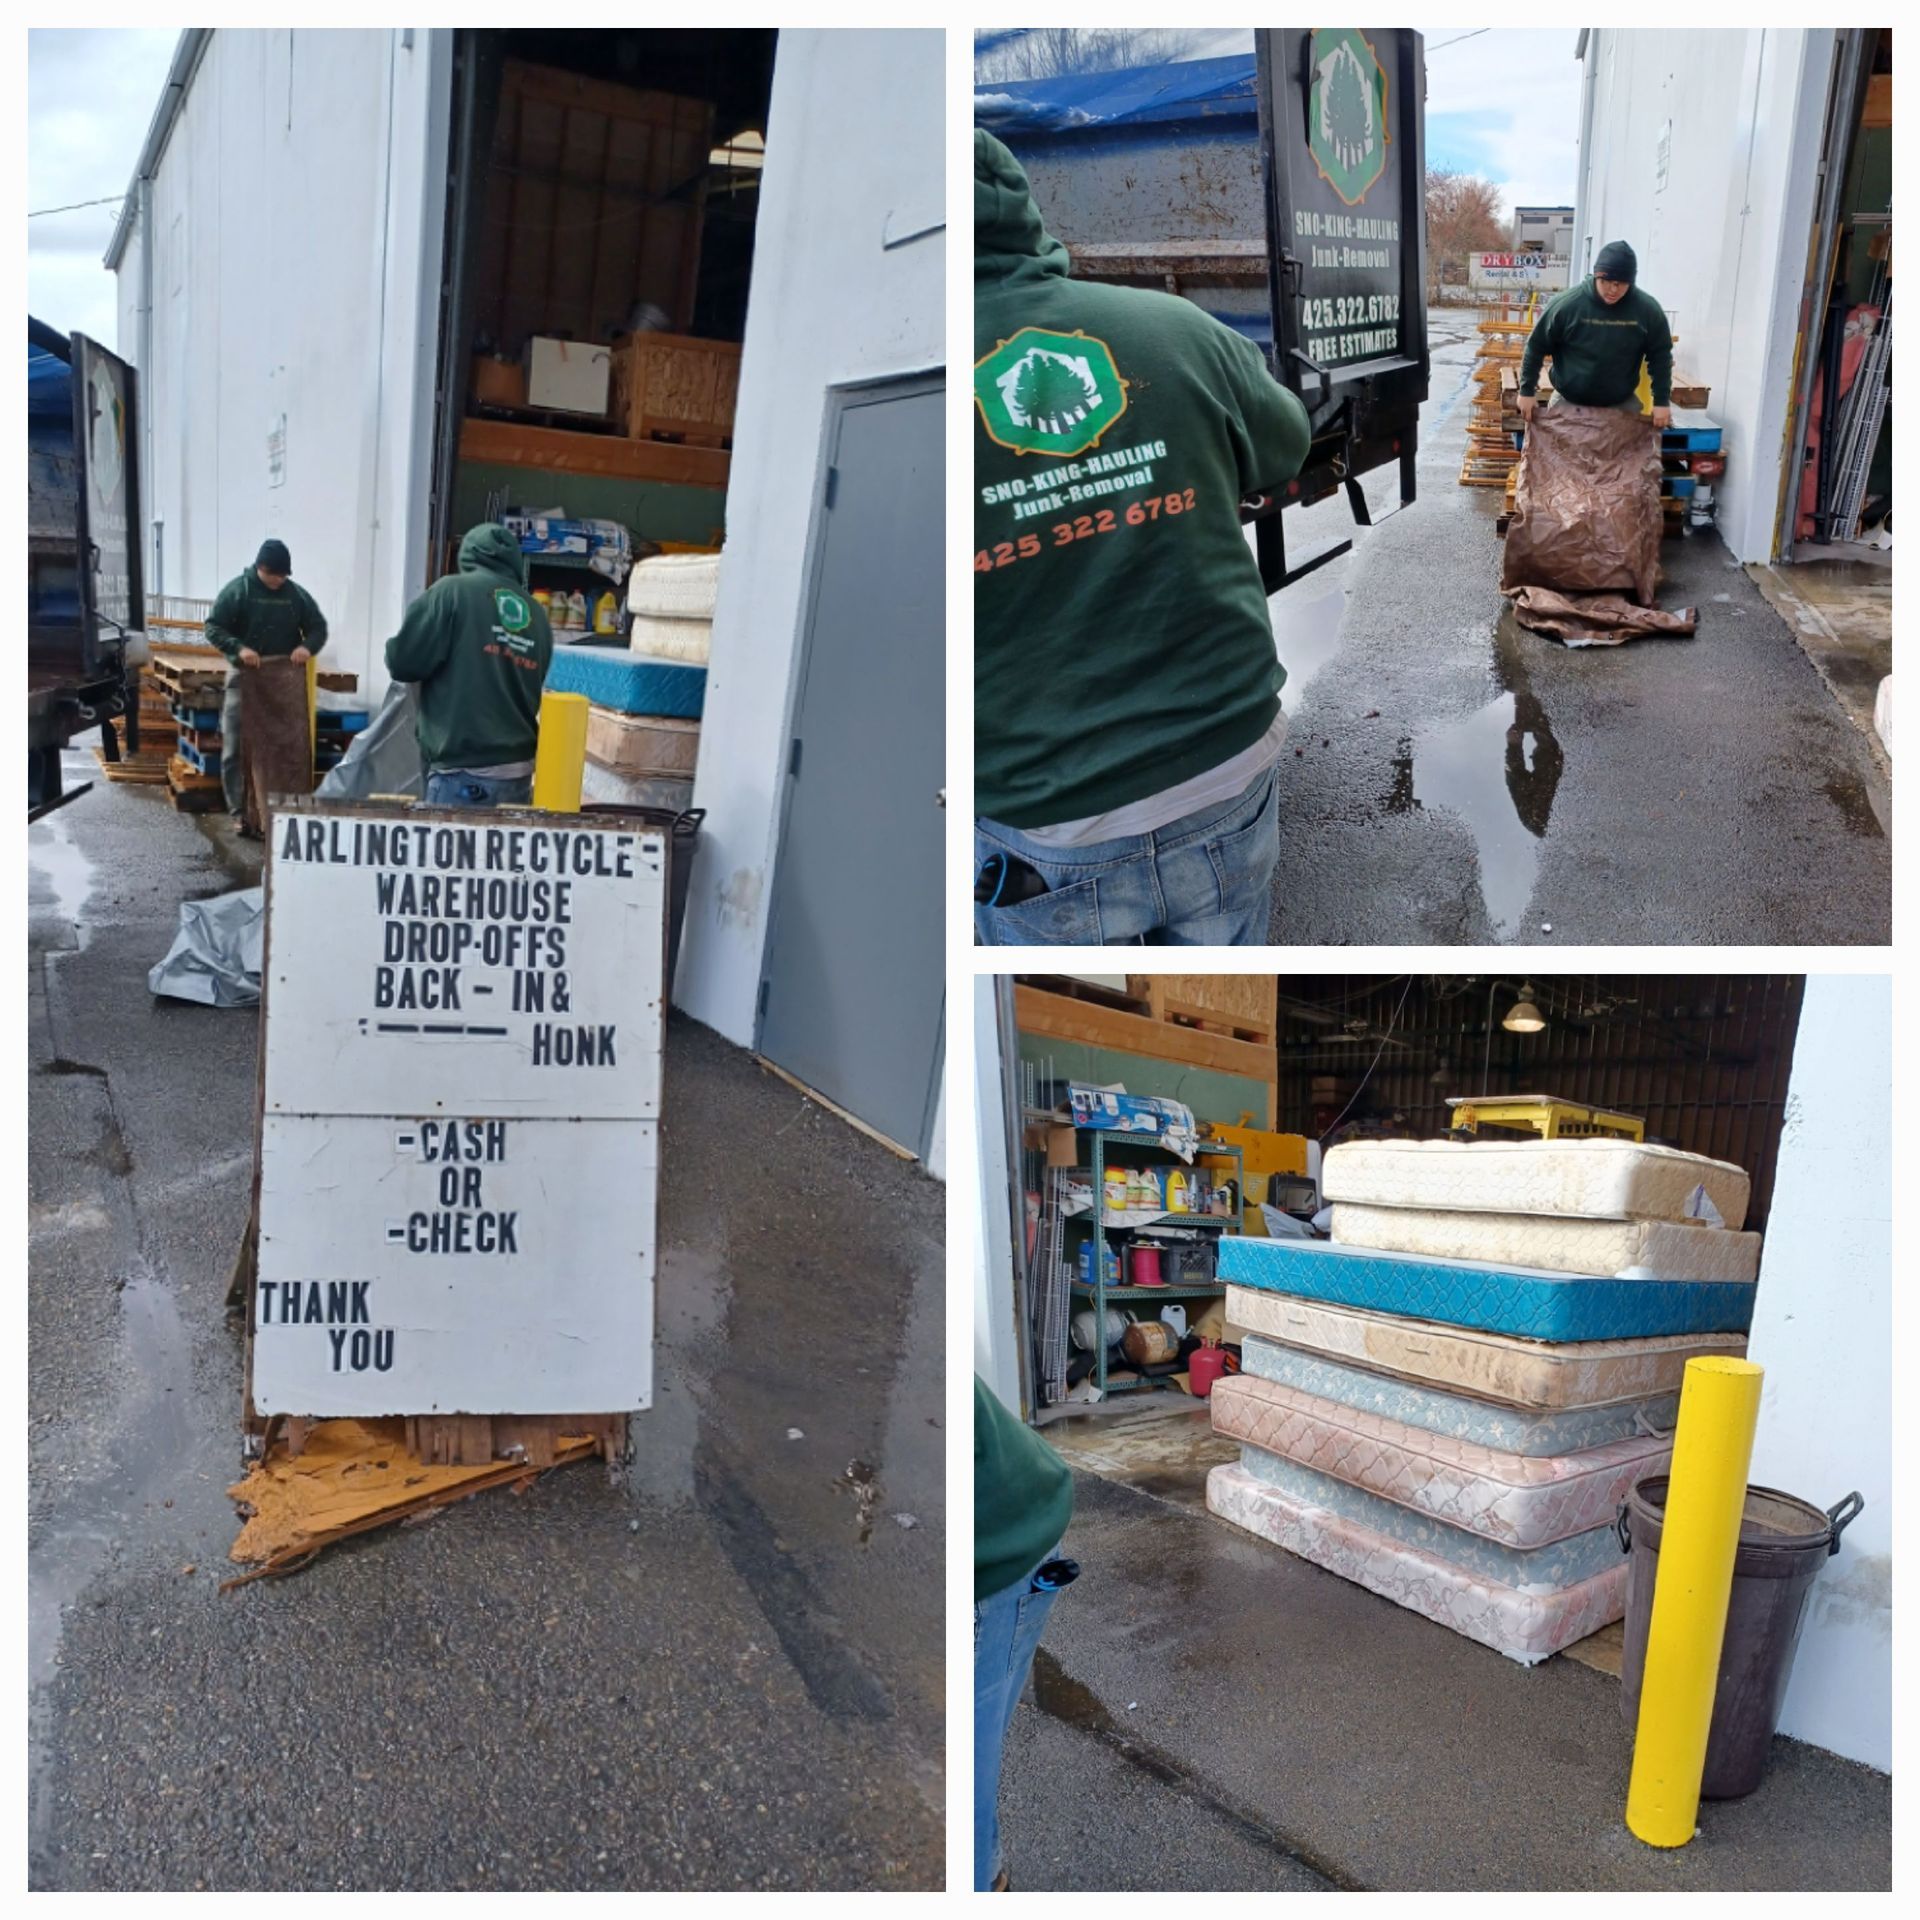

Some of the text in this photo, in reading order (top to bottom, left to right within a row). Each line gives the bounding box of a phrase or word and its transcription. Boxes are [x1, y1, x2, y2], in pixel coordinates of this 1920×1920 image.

[1296, 211, 1399, 241] SNO-KING-HAULING
[1312, 245, 1390, 267] Junk-Removal
[1303, 295, 1399, 330] 425.322.6782
[1308, 328, 1398, 362] FREE ESTIMATES
[981, 440, 1167, 505] SNO-KING-HAULING
[1012, 466, 1154, 520] Junk-Removal
[974, 487, 1196, 572] 425 322 6782
[281, 818, 476, 869] ARLINGTON
[376, 873, 572, 923] WAREHOUSE
[375, 967, 461, 1010] BACK
[533, 1023, 617, 1066] HONK
[439, 1166, 482, 1208] OR
[259, 1280, 371, 1324] THANK
[329, 1329, 395, 1372] YOU
